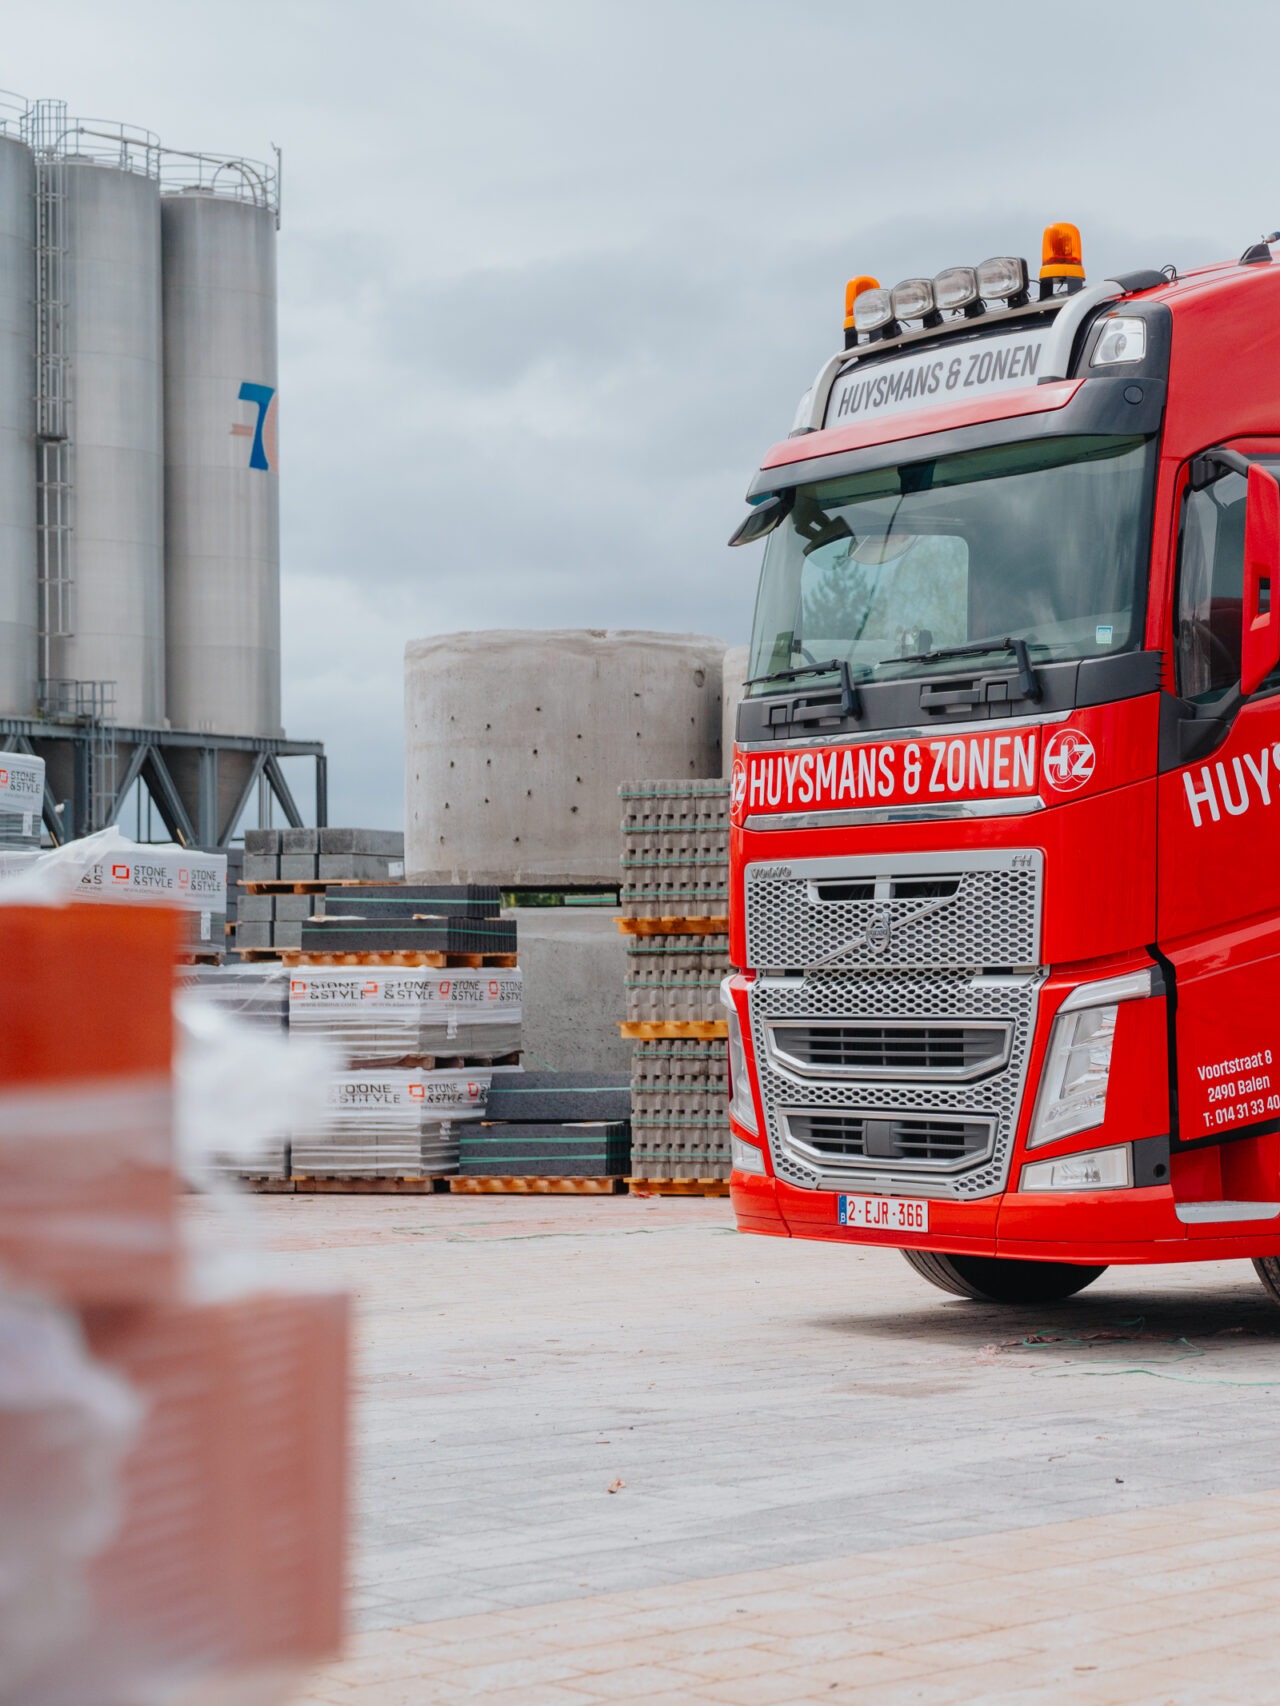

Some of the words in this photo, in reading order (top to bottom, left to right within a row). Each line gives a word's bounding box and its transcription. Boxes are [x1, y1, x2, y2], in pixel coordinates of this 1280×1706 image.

[837, 361, 943, 419] HUYSMANS
[945, 357, 961, 390] &
[963, 343, 1042, 388] ZONEN
[10, 770, 37, 782] STONE
[750, 746, 895, 807] HUYSMANS
[903, 744, 922, 795] &
[929, 735, 1036, 792] ZONEN
[134, 865, 167, 878] STONE
[191, 870, 216, 881] STONE
[133, 876, 173, 888] &STYLE
[191, 880, 221, 892] &STYLE
[453, 981, 480, 991] STONE
[384, 990, 434, 1000] &STYLE
[452, 990, 484, 1001] &STYLE
[1197, 1052, 1264, 1081] Voortstraat
[1264, 1049, 1273, 1064] 8
[428, 1083, 459, 1093] STONE
[1207, 1082, 1236, 1103] 2490
[1237, 1075, 1271, 1095] Balen
[1203, 1112, 1214, 1127] T:
[1215, 1106, 1235, 1124] 014
[1236, 1102, 1249, 1119] 31
[1250, 1098, 1265, 1116] 33
[1266, 1094, 1280, 1111] 40
